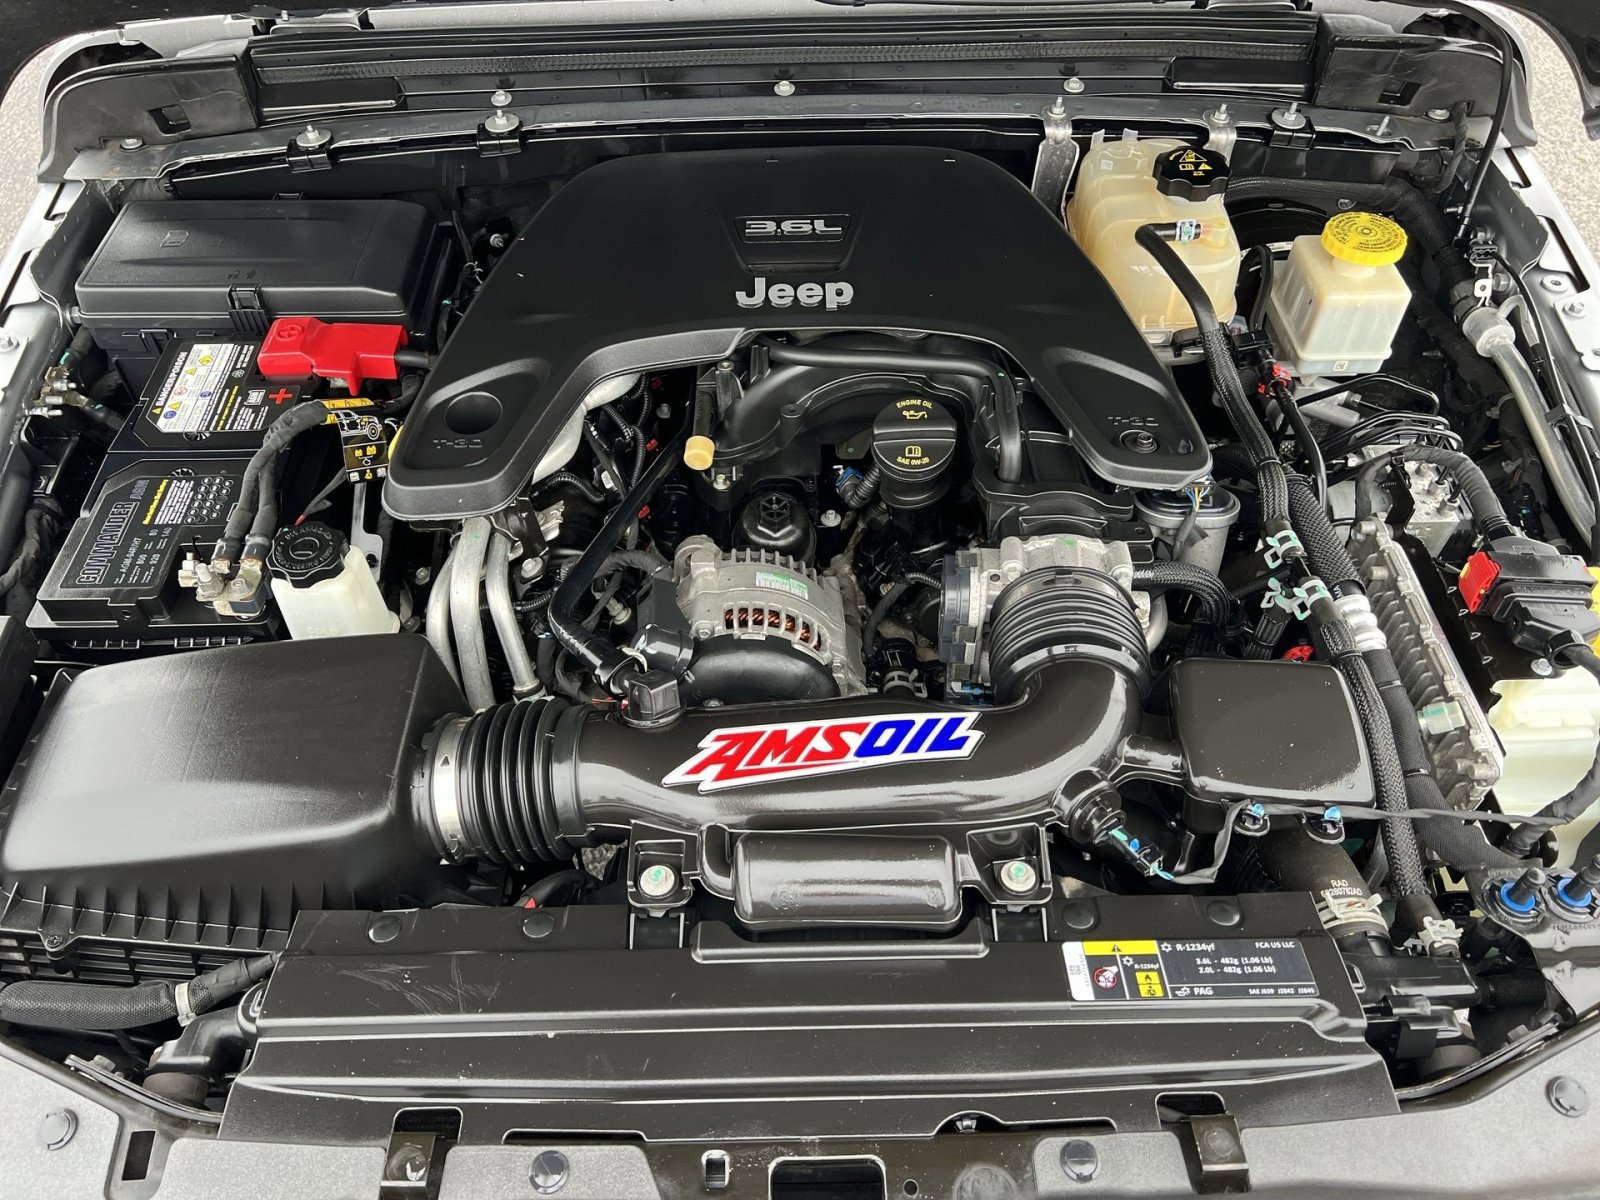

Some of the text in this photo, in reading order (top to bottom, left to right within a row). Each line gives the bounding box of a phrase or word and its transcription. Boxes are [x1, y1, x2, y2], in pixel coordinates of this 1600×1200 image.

[745, 220, 842, 236] 3.6L
[736, 277, 854, 311] Jeep
[156, 352, 188, 406] DANGER/POISON
[896, 400, 932, 409] ENGINE OIL
[897, 456, 910, 465] SAE
[76, 502, 140, 584] COMMANDER
[684, 716, 970, 782] AMSOIL
[1176, 943, 1215, 952] R-1234yf
[1241, 957, 1260, 965] (1.06
[1244, 966, 1263, 974] (1.06
